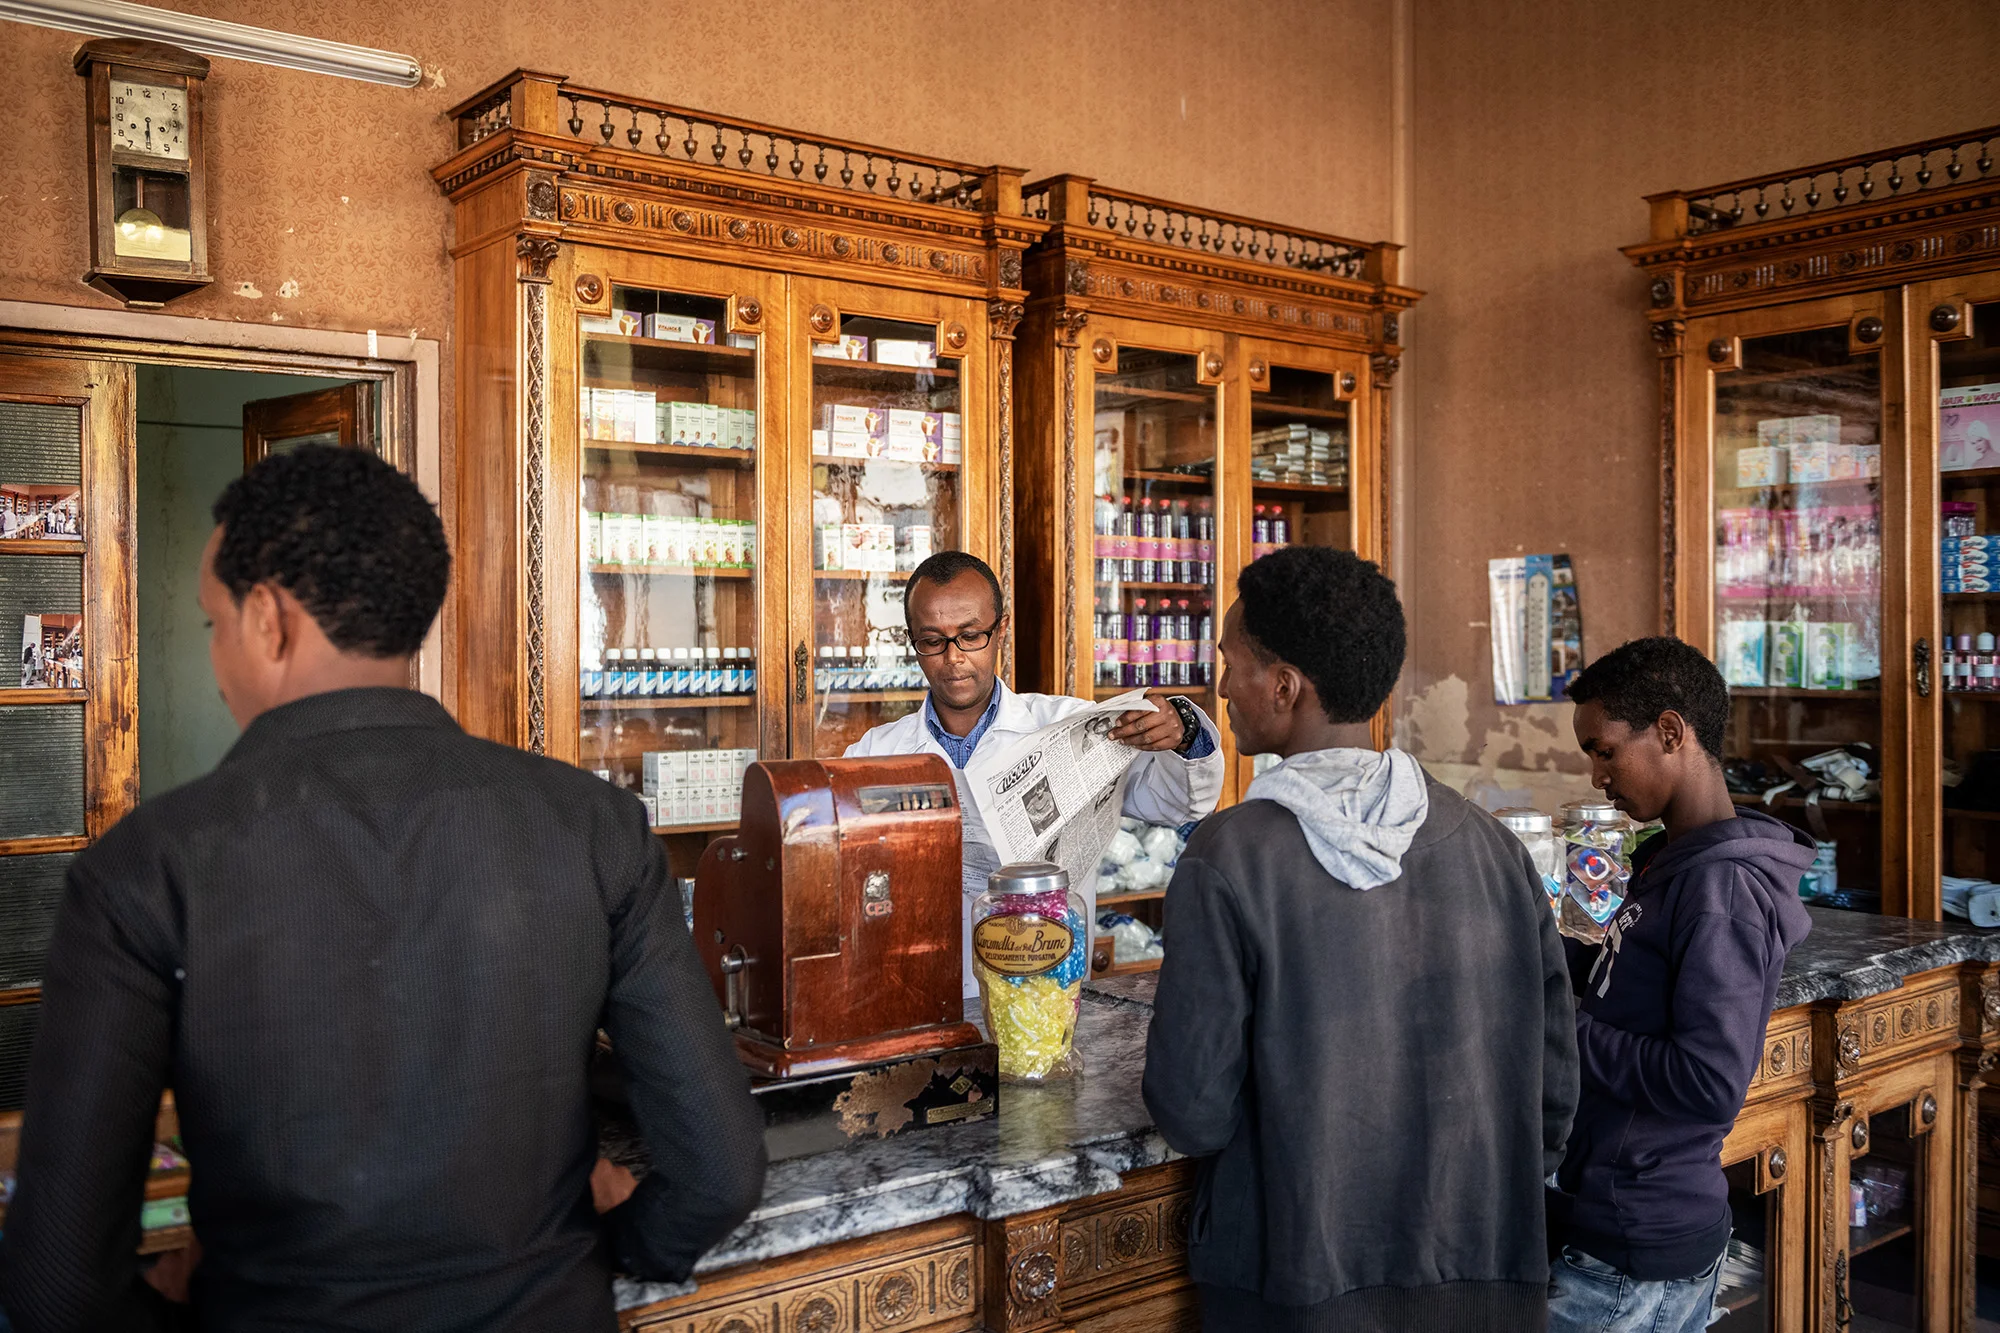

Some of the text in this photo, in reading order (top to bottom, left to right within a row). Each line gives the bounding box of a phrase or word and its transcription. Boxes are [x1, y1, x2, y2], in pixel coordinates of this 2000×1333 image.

[126, 88, 133, 97] 11
[143, 90, 151, 98] 12
[162, 92, 166, 100] 1
[171, 103, 178, 111] 2
[117, 113, 124, 121] 9
[118, 129, 124, 137] 8
[128, 140, 134, 148] 7
[164, 144, 170, 152] 5
[1941, 395, 1965, 406] HAIR
[976, 927, 1015, 951] Caramella
[1031, 930, 1067, 953] Bruno
[1028, 953, 1057, 961] PURGATIVA
